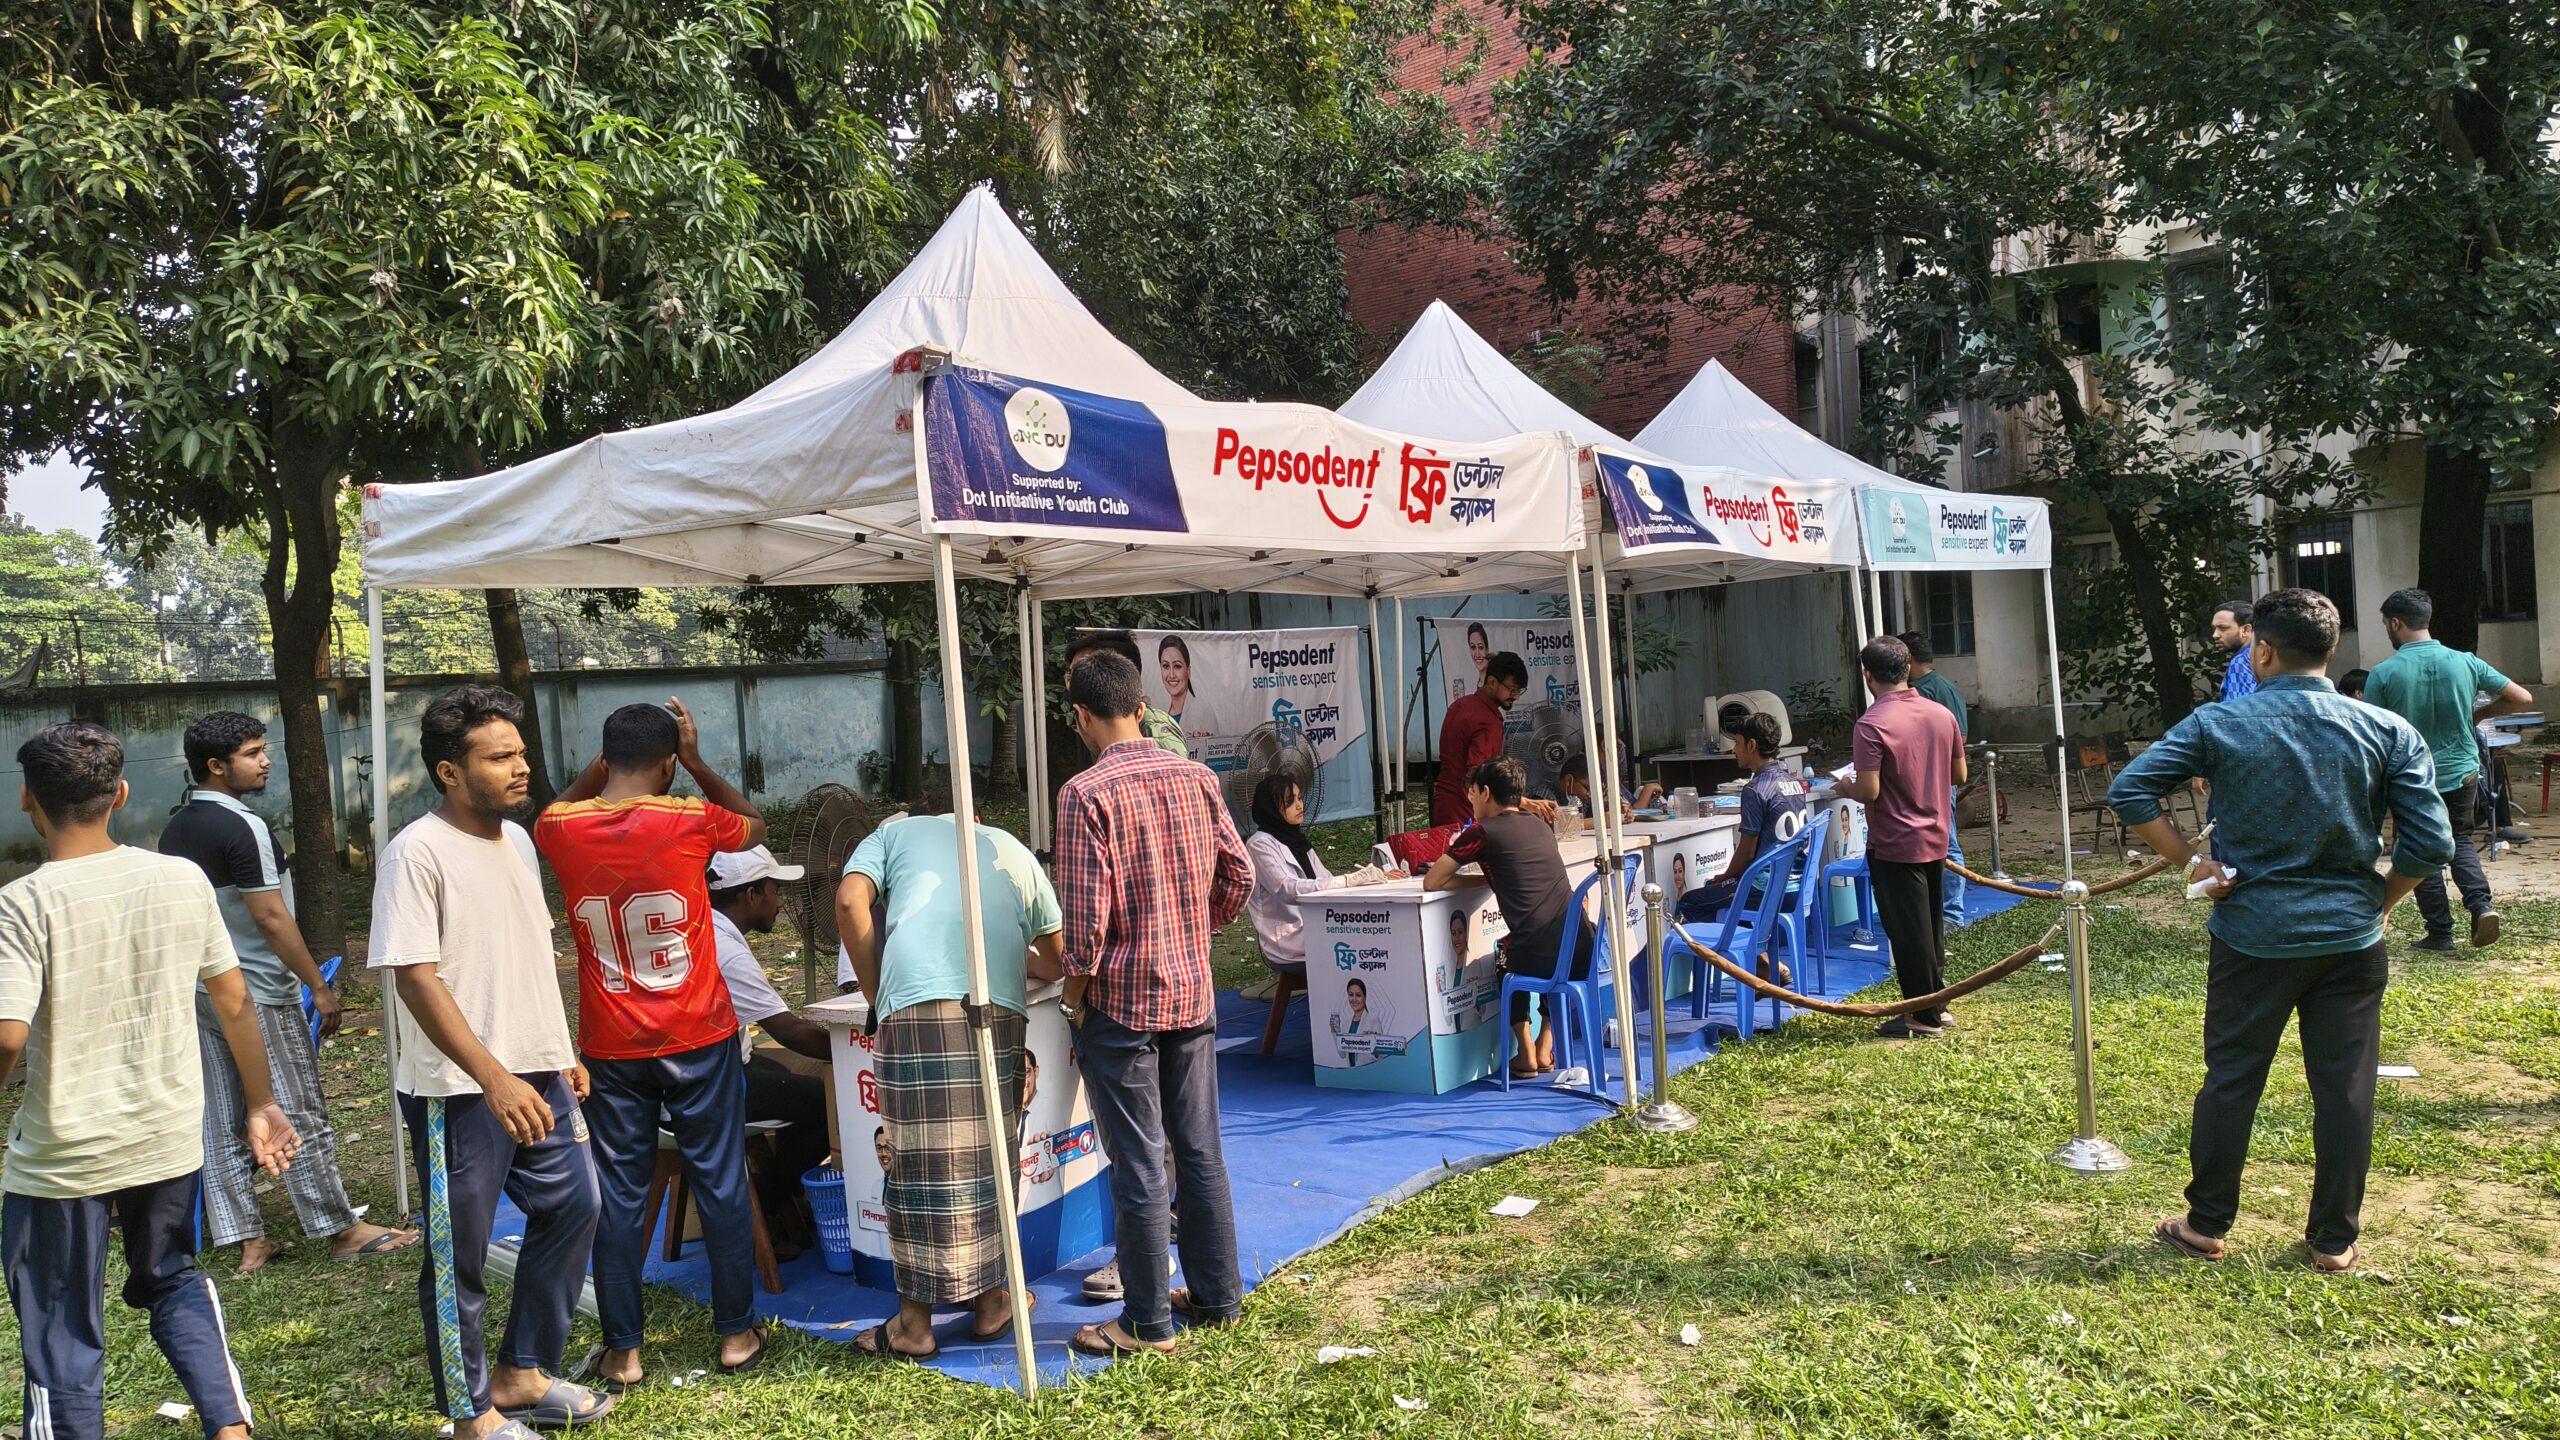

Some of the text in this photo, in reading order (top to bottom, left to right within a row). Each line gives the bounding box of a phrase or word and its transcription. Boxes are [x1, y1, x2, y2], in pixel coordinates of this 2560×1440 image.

[1045, 433, 1066, 448] DU
[1213, 427, 1381, 491] Pepsodent
[1012, 473, 1082, 493] Supported by:
[1399, 442, 1450, 523] ফ্রি
[1454, 457, 1505, 493] ডেন্টাল
[963, 488, 1129, 516] Dot Initiative Youth Club
[1450, 497, 1495, 526] ক্যাম্প
[1703, 485, 1769, 525] Pepsodent
[1771, 485, 1799, 544] ফ্রি
[1940, 504, 1987, 534] Pepsodent
[1941, 535, 1988, 552] sensitive expert
[1248, 642, 1335, 673] Pepsodent
[1252, 671, 1336, 689] sensitive expert
[1304, 702, 1340, 724] ডেন্টাল
[1696, 848, 1727, 867] Pepsodent
[1325, 909, 1391, 926] Pepsodent
[1326, 925, 1391, 936] sensitive expert
[574, 889, 693, 993] 16
[1358, 948, 1388, 961] ডেন্টাল
[1333, 941, 1356, 971] ফ্রি
[1341, 1037, 1371, 1047] Pepsodent
